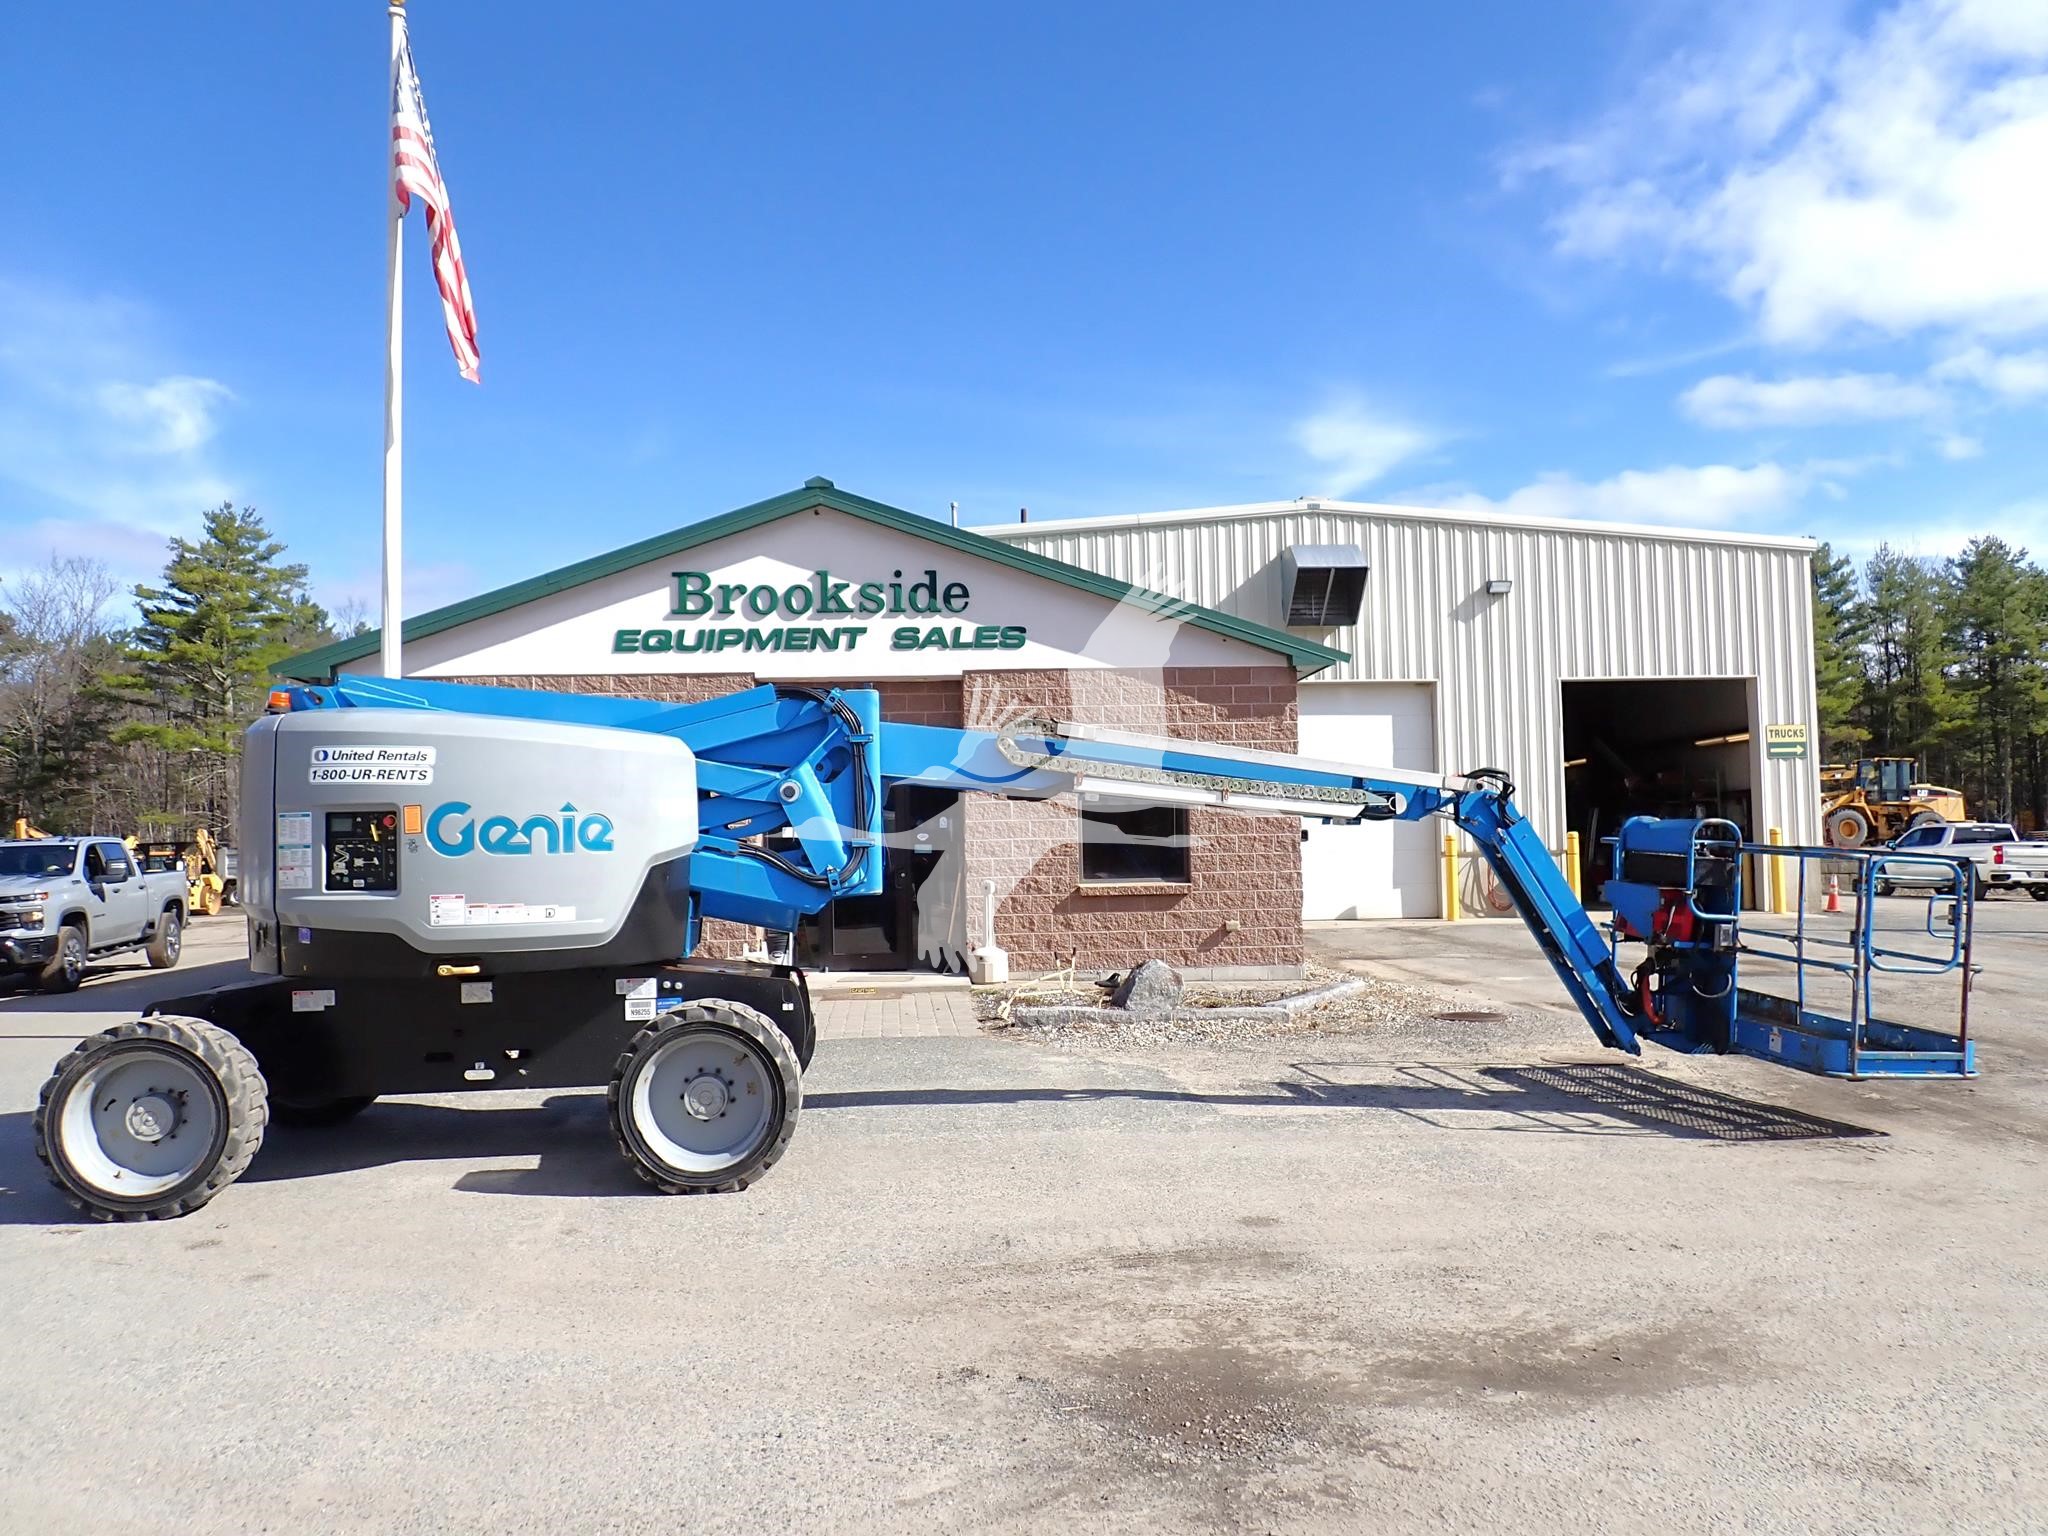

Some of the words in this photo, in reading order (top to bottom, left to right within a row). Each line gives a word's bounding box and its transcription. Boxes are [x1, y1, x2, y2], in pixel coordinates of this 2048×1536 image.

[671, 570, 970, 614] Brookside
[614, 627, 867, 653] EQUIPMENT
[893, 626, 1027, 650] SALES
[1768, 729, 1805, 739] TRUCKS
[332, 750, 374, 761] United
[377, 750, 428, 762] Rentals
[311, 769, 428, 781] 1-800-UR-RENTS
[425, 801, 614, 858] Genie
